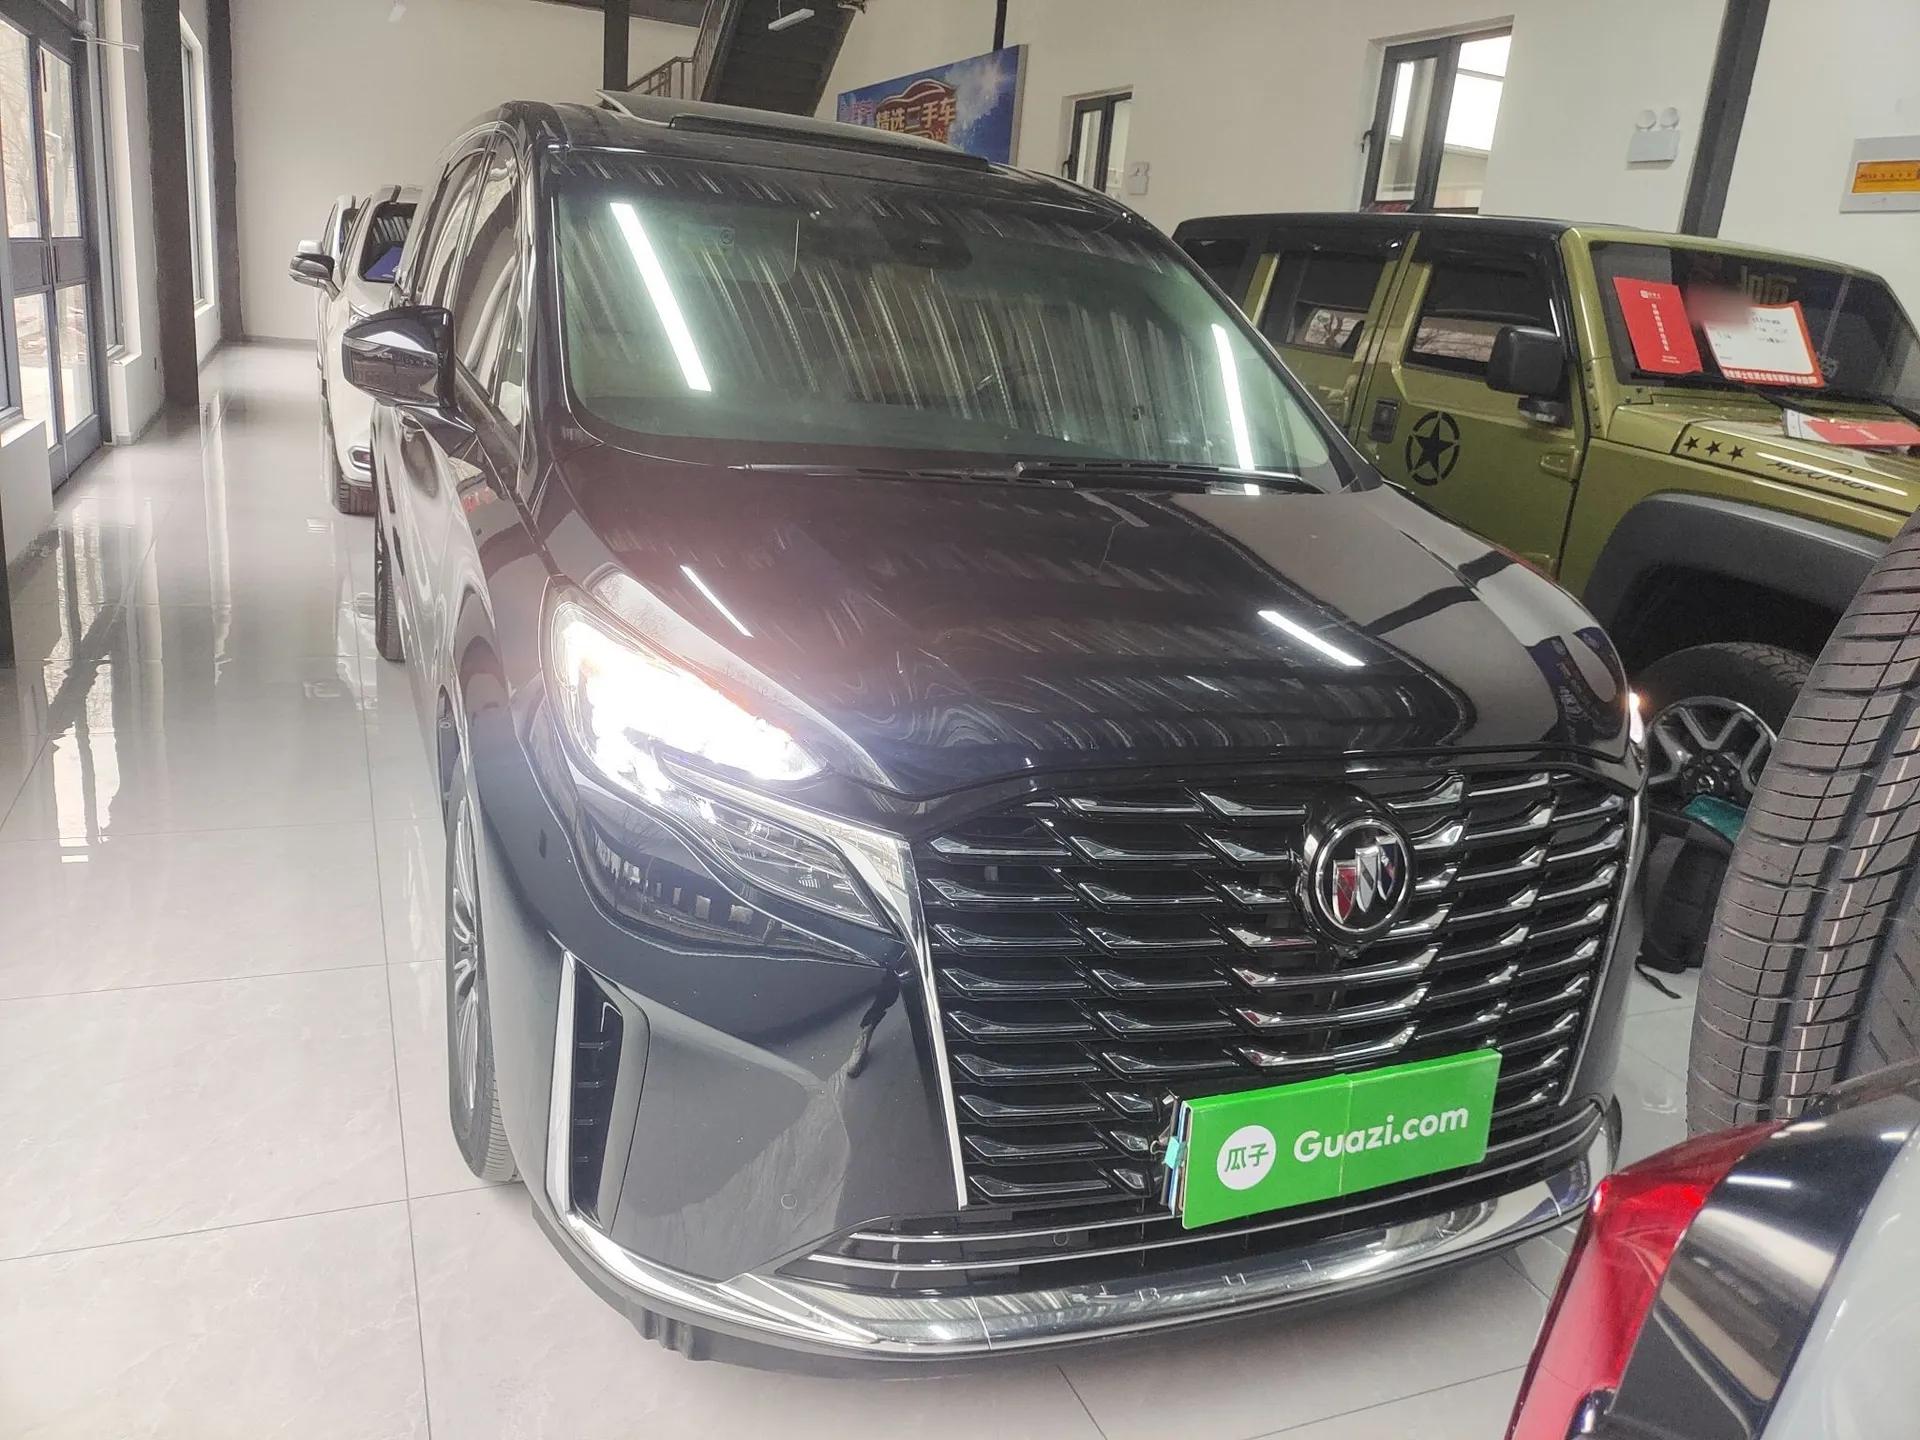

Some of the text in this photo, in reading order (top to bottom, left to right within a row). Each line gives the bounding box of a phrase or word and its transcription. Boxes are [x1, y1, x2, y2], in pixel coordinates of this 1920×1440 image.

[876, 97, 957, 133] 精选二手车
[1224, 1106, 1469, 1173] 瓜子 Guazi.com
